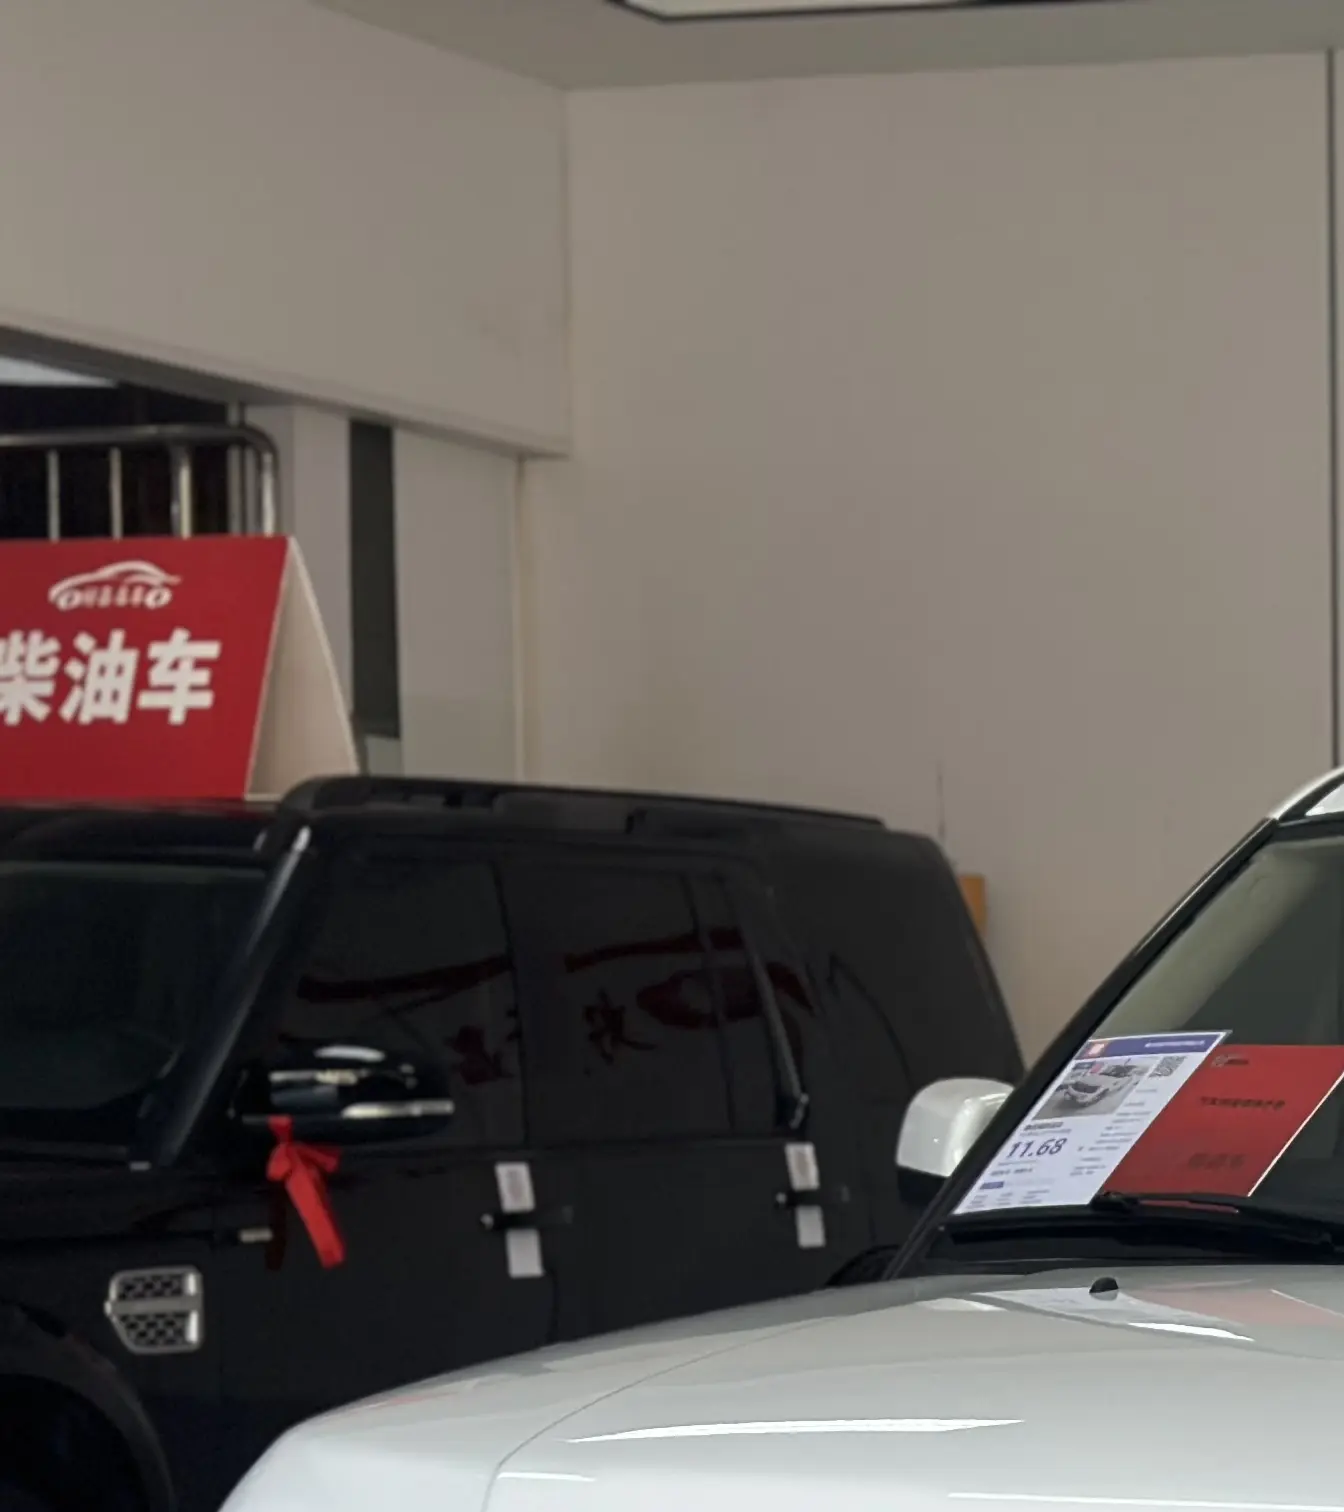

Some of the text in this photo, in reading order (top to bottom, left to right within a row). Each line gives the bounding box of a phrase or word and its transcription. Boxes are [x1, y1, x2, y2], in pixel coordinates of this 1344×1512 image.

[0, 628, 222, 726] 柴油车
[1006, 1136, 1068, 1158] 11.68
